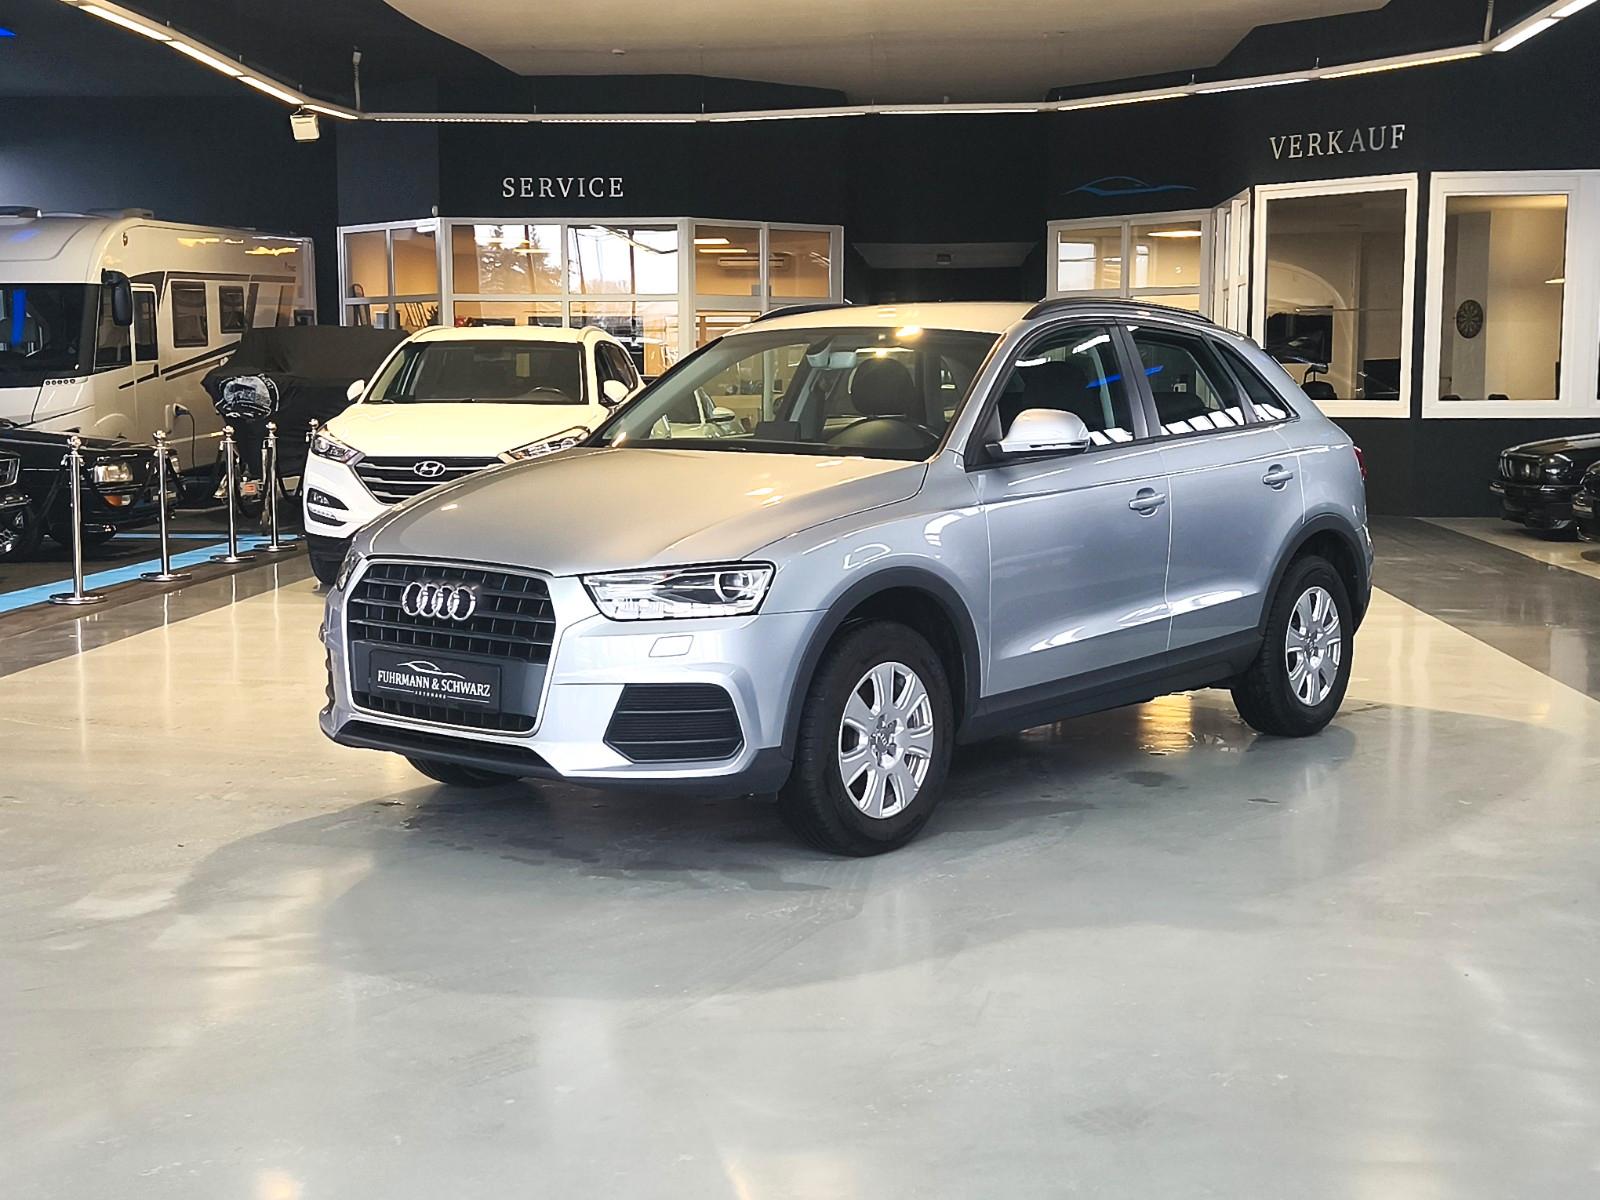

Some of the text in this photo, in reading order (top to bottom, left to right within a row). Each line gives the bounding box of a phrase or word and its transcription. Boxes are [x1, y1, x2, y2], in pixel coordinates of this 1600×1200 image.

[1269, 124, 1406, 160] VERKAUF
[502, 177, 624, 198] SERVICE
[377, 670, 430, 689] FUHRMANN
[431, 678, 440, 690] &
[441, 679, 491, 697] SCHWARZ
